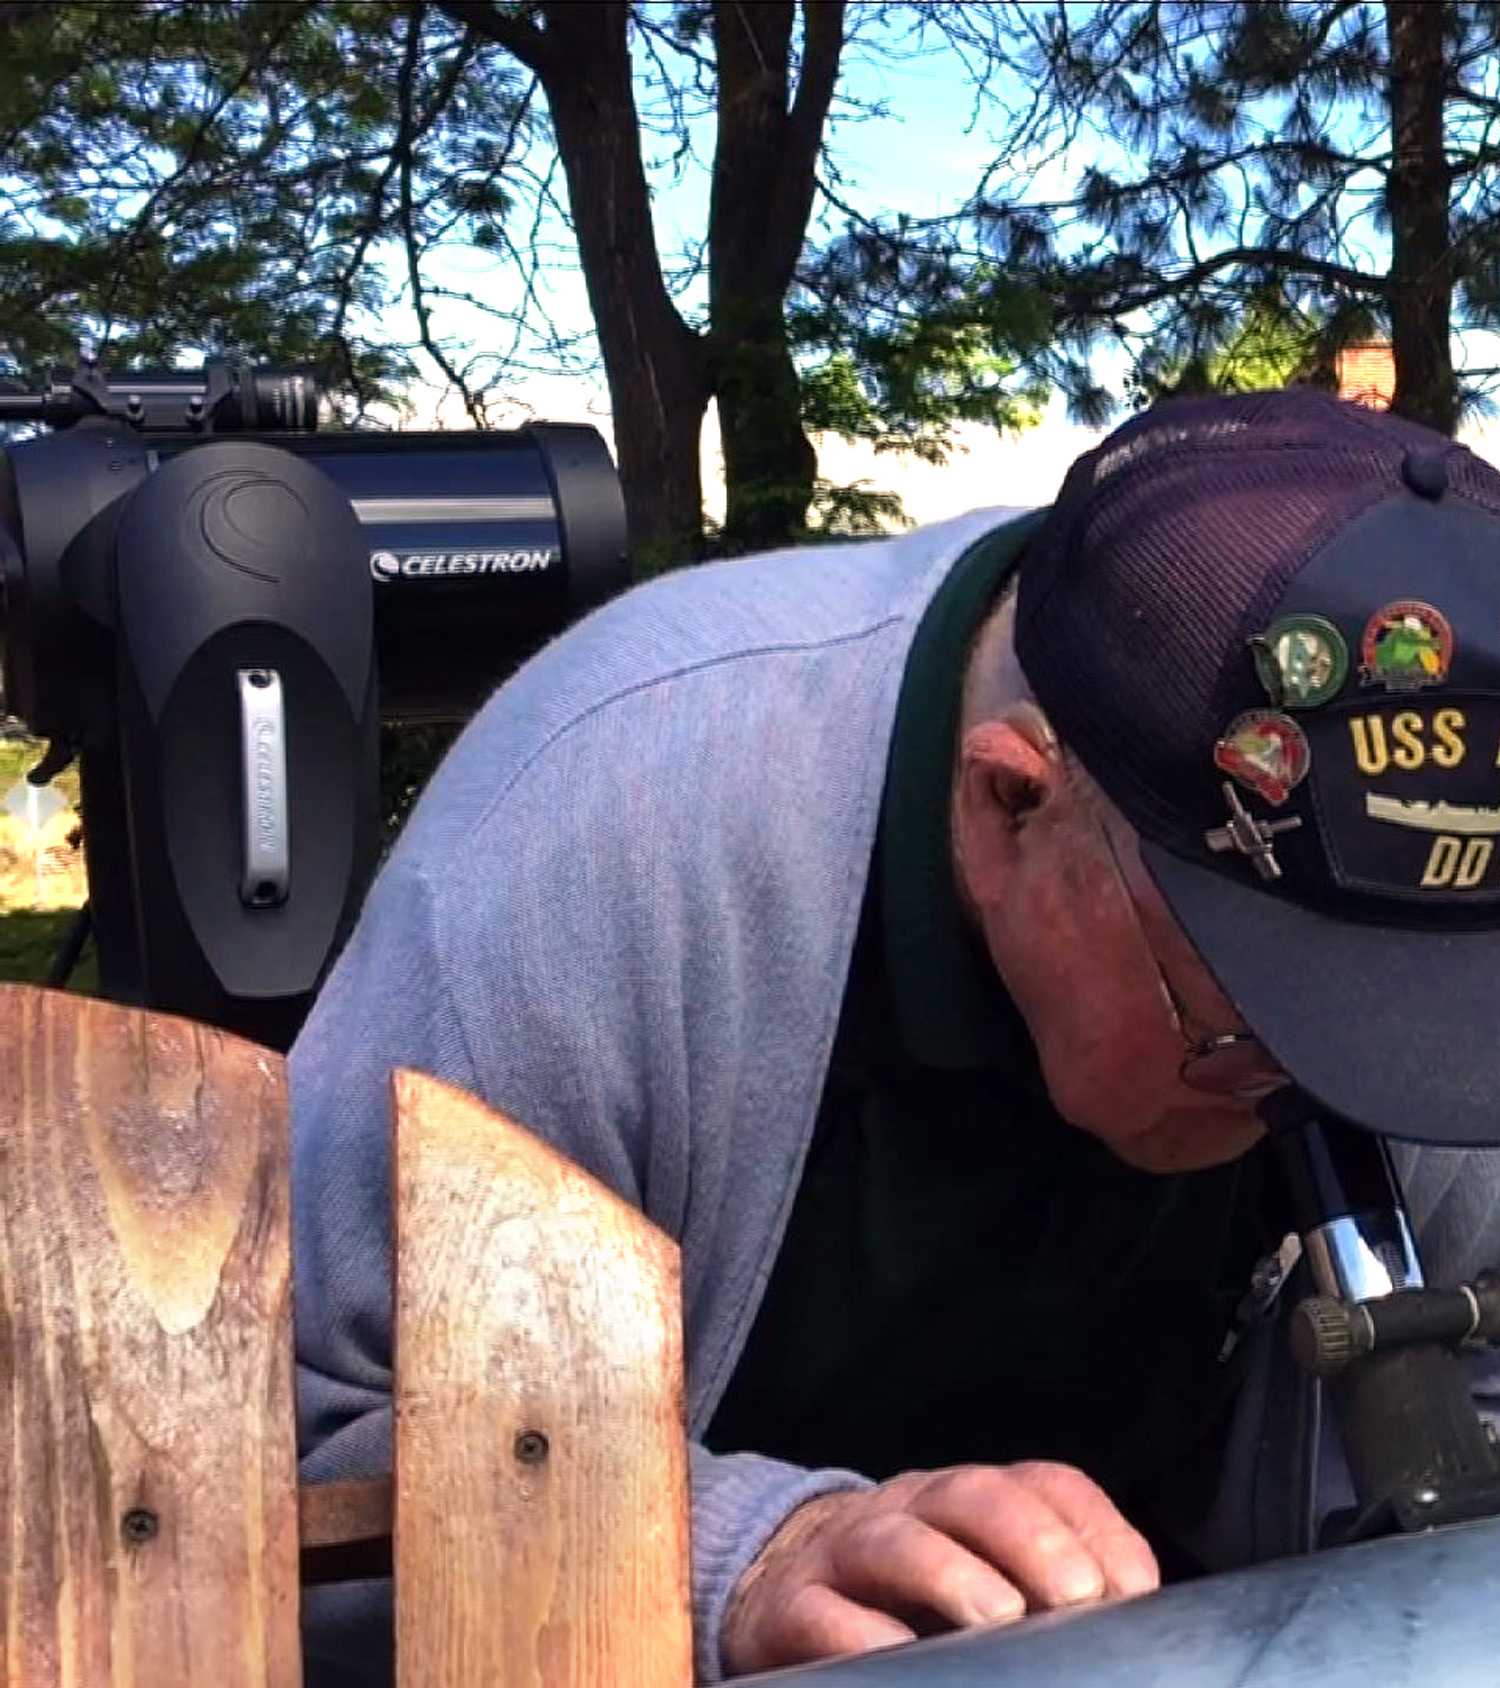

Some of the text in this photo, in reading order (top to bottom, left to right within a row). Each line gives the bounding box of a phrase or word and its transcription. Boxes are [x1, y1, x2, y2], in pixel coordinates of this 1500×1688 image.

[401, 551, 551, 575] CELESTRON
[1350, 708, 1466, 776] USS
[1420, 835, 1494, 889] DD
